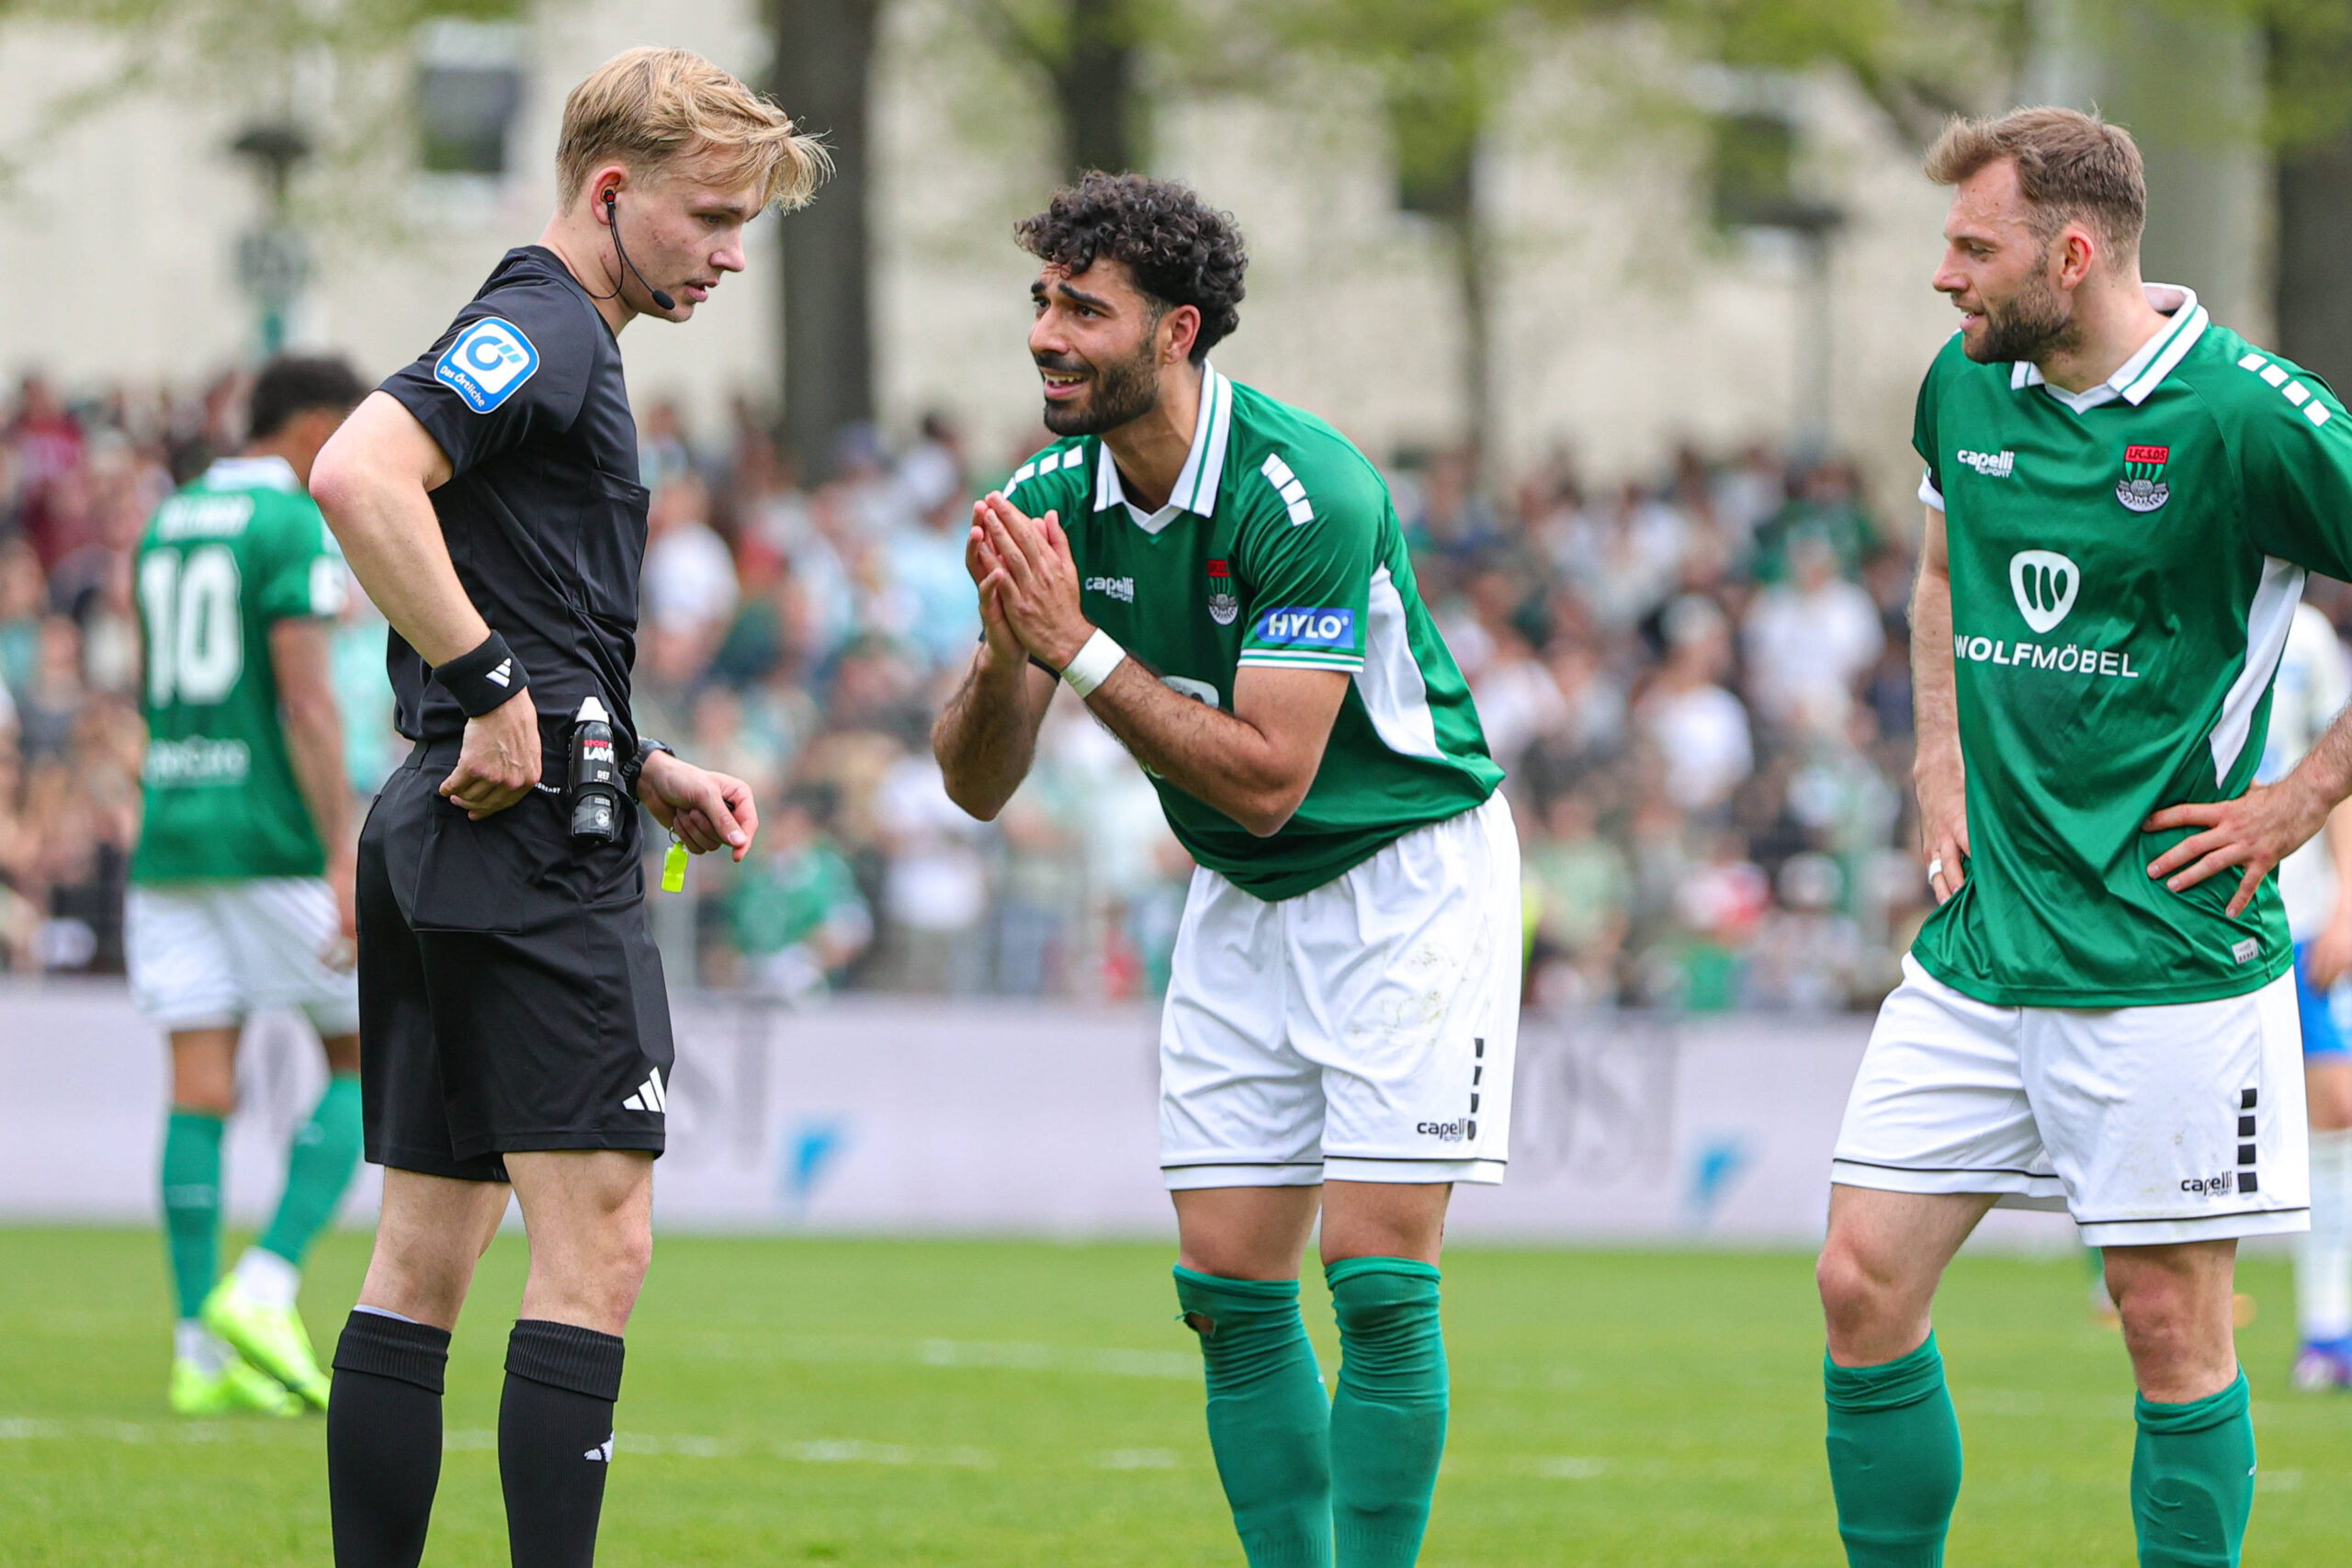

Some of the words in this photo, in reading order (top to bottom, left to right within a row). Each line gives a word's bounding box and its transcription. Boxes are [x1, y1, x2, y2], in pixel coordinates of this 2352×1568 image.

[439, 366, 456, 378] Das
[454, 372, 486, 407] Örtliche
[1957, 449, 2015, 471] capelli
[1085, 576, 1134, 596] capelli
[141, 547, 243, 709] 10
[1954, 634, 2139, 678] WOLFMÖBEL
[1417, 1118, 1467, 1140] capell
[2181, 1170, 2232, 1196] capelli
